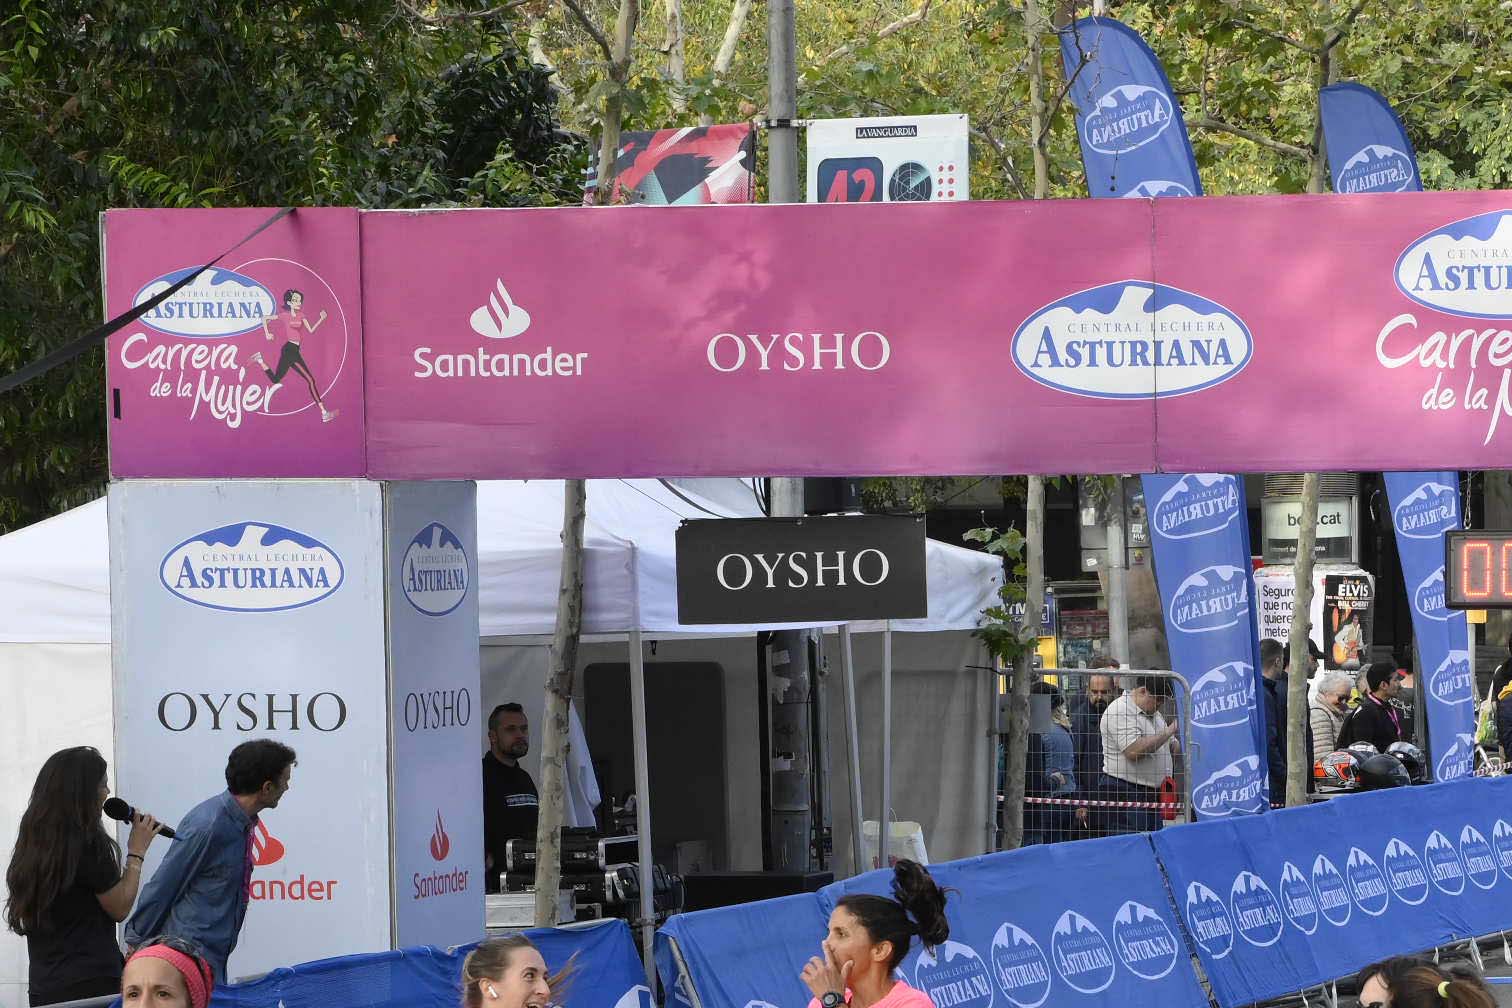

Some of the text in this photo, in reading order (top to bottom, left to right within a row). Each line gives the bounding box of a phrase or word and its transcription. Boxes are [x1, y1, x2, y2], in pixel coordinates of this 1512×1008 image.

[867, 126, 916, 136] VANGUARDIA
[1067, 321, 1226, 334] CENTRAL LECHERA
[120, 332, 239, 370] Carrera
[413, 345, 589, 378] Santander
[706, 331, 891, 372] OYSHO
[1030, 325, 1235, 369] ASTURIANA
[150, 371, 193, 398] de la
[189, 367, 284, 428] Mujer
[1421, 370, 1489, 410] de la
[175, 555, 331, 590] ASTURIANA
[202, 552, 325, 562] CENTRAL LECHERA
[716, 549, 889, 590] OYSHO
[407, 557, 466, 593] ASTURIANA
[1338, 584, 1369, 597] ELVIS
[1263, 601, 1280, 611] que
[157, 691, 348, 732] OYSHO
[404, 687, 471, 733] OYSHO
[413, 865, 469, 900] Santander
